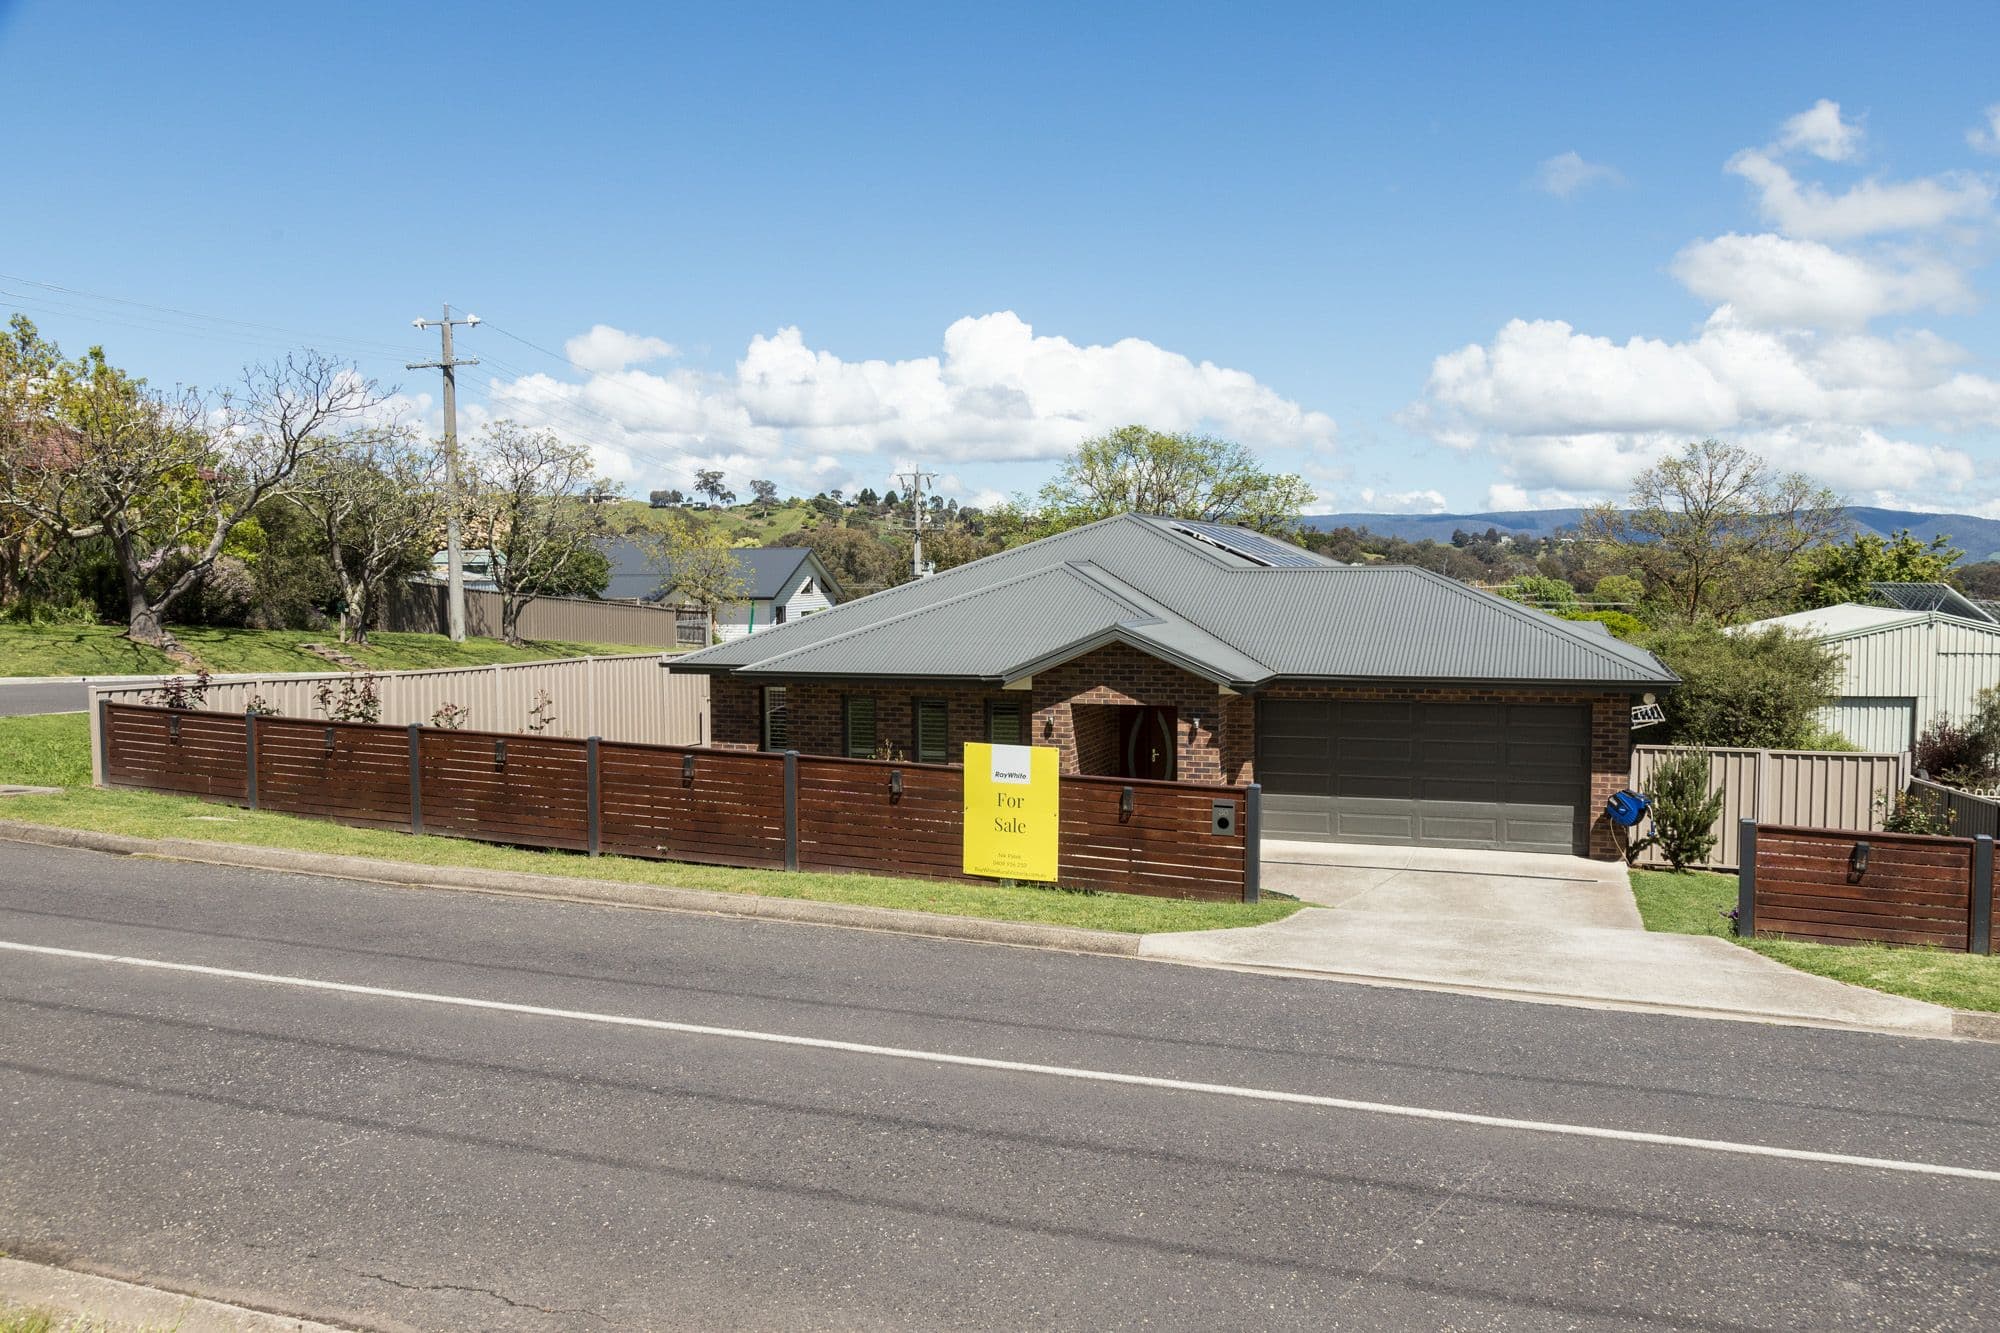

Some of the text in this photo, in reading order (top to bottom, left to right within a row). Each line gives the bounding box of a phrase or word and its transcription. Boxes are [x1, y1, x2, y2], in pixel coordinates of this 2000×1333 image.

[995, 771, 1027, 780] RayWhite
[998, 792, 1025, 809] For
[994, 816, 1026, 834] Sale
